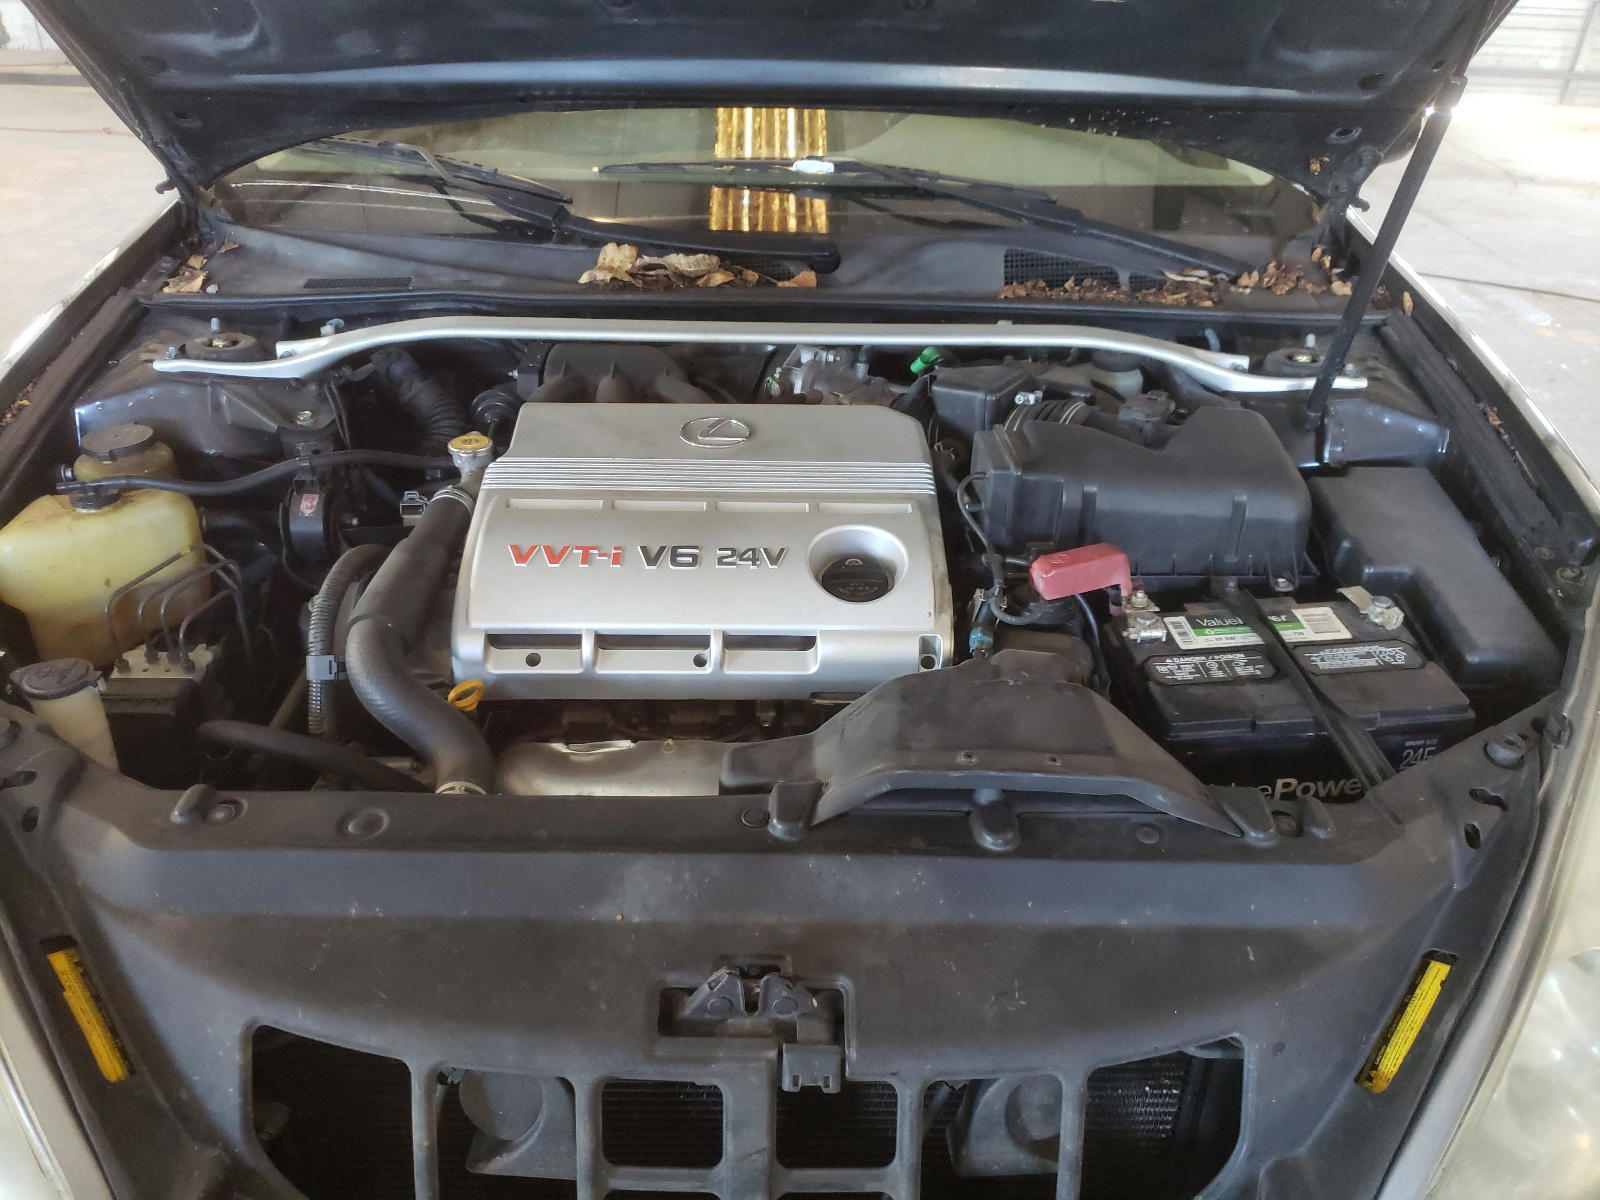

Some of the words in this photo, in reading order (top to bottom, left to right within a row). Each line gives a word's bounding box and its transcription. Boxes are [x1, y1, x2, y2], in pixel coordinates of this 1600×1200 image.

[508, 544, 623, 568] VVT-i
[637, 544, 702, 569] V6
[715, 547, 787, 569] 24V
